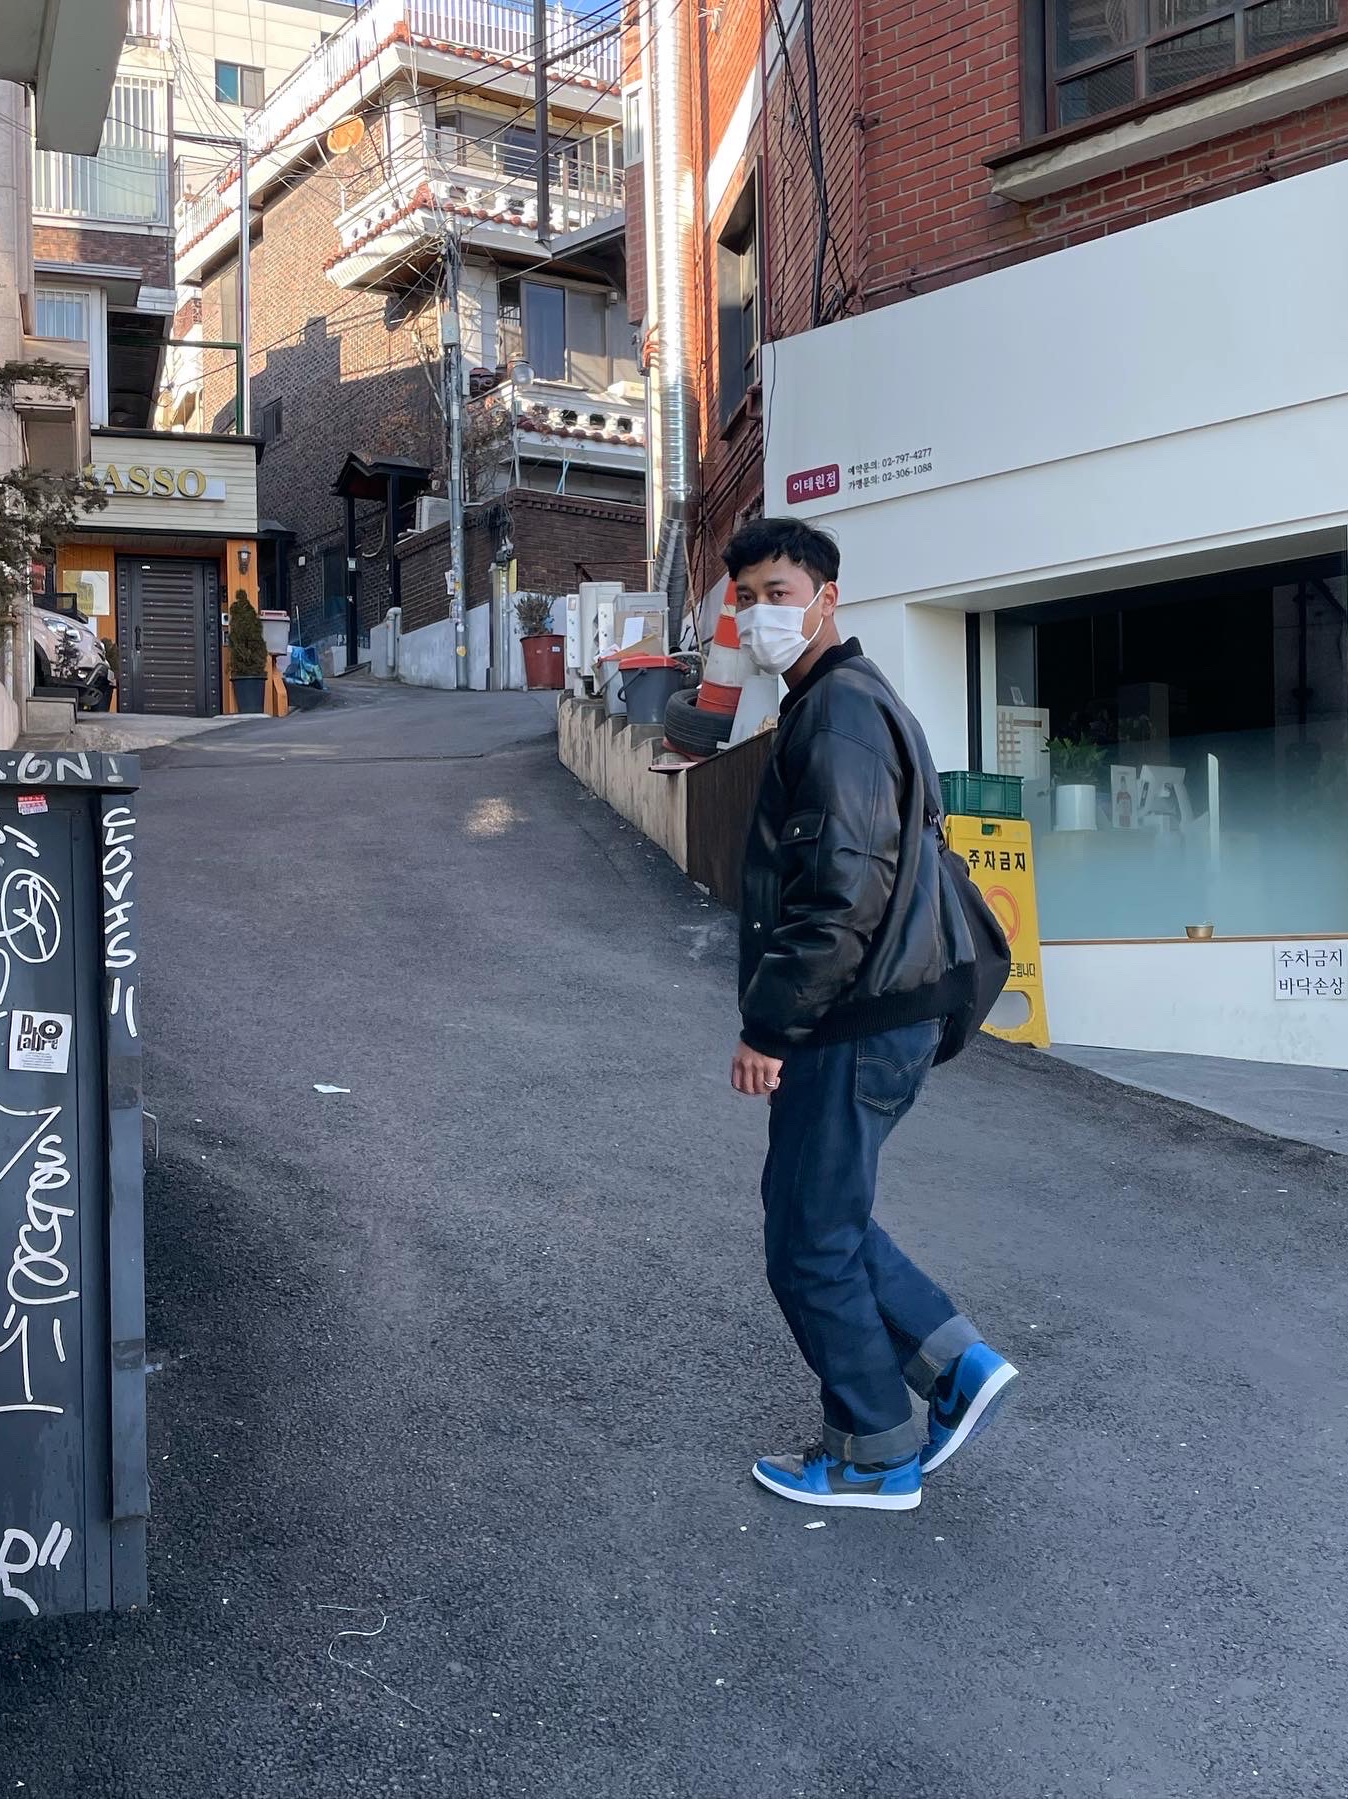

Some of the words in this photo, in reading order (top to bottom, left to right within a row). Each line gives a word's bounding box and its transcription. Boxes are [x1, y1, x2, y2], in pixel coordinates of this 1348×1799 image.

[882, 447, 932, 467] 02-797-4277
[792, 470, 836, 493] 이태원점
[882, 462, 932, 482] 02-306-1088
[968, 849, 1026, 871] 주차금지
[1278, 948, 1342, 967] 주차금지
[1279, 977, 1345, 995] 바닥손상
